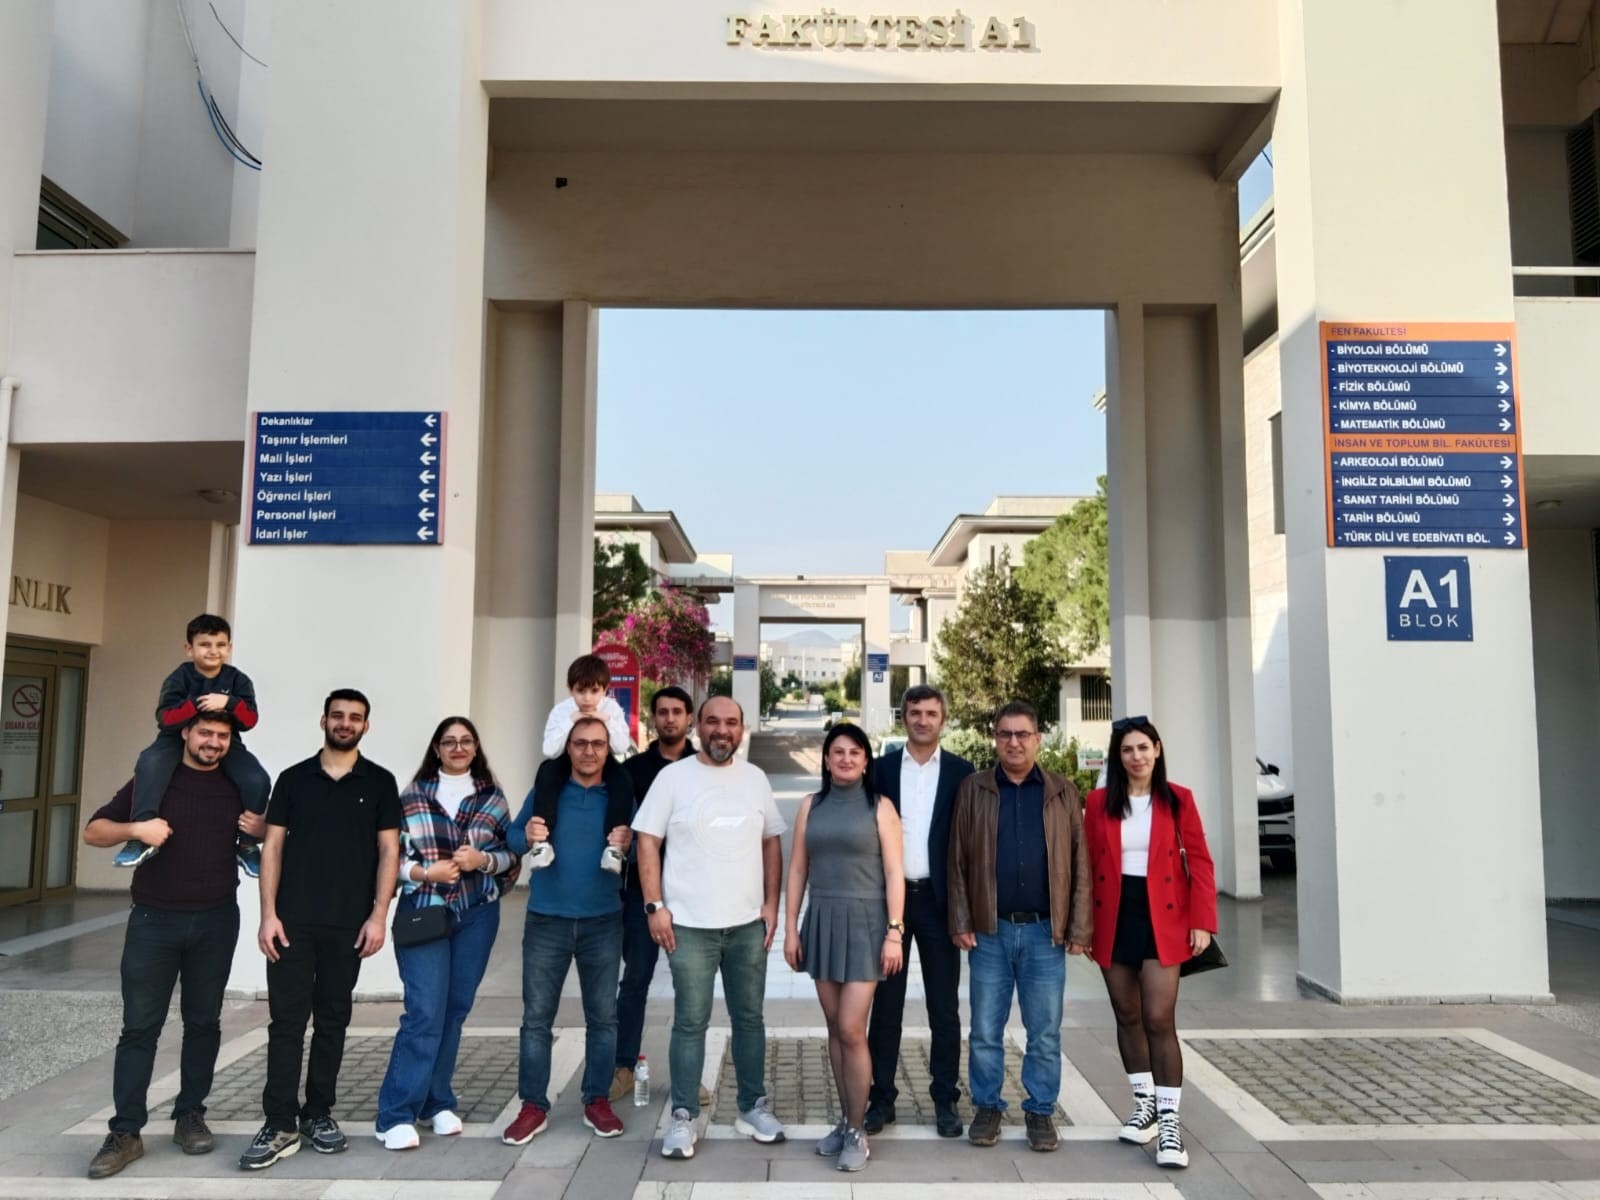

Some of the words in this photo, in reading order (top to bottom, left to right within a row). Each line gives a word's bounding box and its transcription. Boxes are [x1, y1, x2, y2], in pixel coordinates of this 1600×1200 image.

[726, 8, 966, 48] FAKÜLTESİ
[979, 16, 1032, 48] A1
[1331, 327, 1351, 336] FEN
[1336, 343, 1383, 355] BİYOLOJİ
[1384, 343, 1429, 356] BÖLÜMÜ
[1337, 361, 1418, 374] BİYOTEKNOLOJİ
[1420, 361, 1465, 374] BÖLÜMÜ
[1339, 380, 1365, 392] FİZİK
[1366, 380, 1411, 392] BÖLÜMÜ
[1339, 399, 1372, 411] KİMYA
[1372, 399, 1417, 411] BÖLÜMÜ
[260, 416, 314, 426] Dekanlıklar
[1340, 418, 1400, 429] MATEMATİK
[1401, 417, 1446, 430] BÖLÜMÜ
[260, 434, 298, 447] Taşınır
[300, 432, 348, 446] İşlemleri
[1369, 439, 1383, 447] VE
[1386, 438, 1429, 448] TOPLUM
[259, 453, 283, 464] Mali
[285, 451, 313, 465] İşleri
[1339, 455, 1398, 467] ARKEOLOJİ
[1400, 455, 1445, 467] BÖLÜMÜ
[259, 471, 283, 483] Yazı
[285, 470, 313, 483] İşleri
[1341, 475, 1378, 487] İNGİLİZ
[1427, 475, 1472, 488] BÖLÜMÜ
[256, 489, 301, 503] Öğrenci
[303, 489, 331, 502] İşleri
[1343, 494, 1378, 505] SANAT
[1379, 493, 1413, 505] TARİHİ
[1415, 493, 1460, 506] BÖLÜMÜ
[256, 509, 306, 520] Personel
[308, 507, 337, 521] İşleri
[1342, 511, 1374, 523] TARİH
[1376, 511, 1421, 524] BÖLÜMÜ
[255, 526, 281, 539] İdari
[283, 526, 308, 540] İşler
[1343, 530, 1373, 543] TÜRK
[1374, 530, 1395, 543] DİLİ
[1395, 532, 1410, 543] VE
[1412, 531, 1465, 543] EDEBİYATI
[1466, 532, 1491, 544] BÖL.
[1399, 569, 1459, 608] A1
[1399, 613, 1459, 627] BLOK
